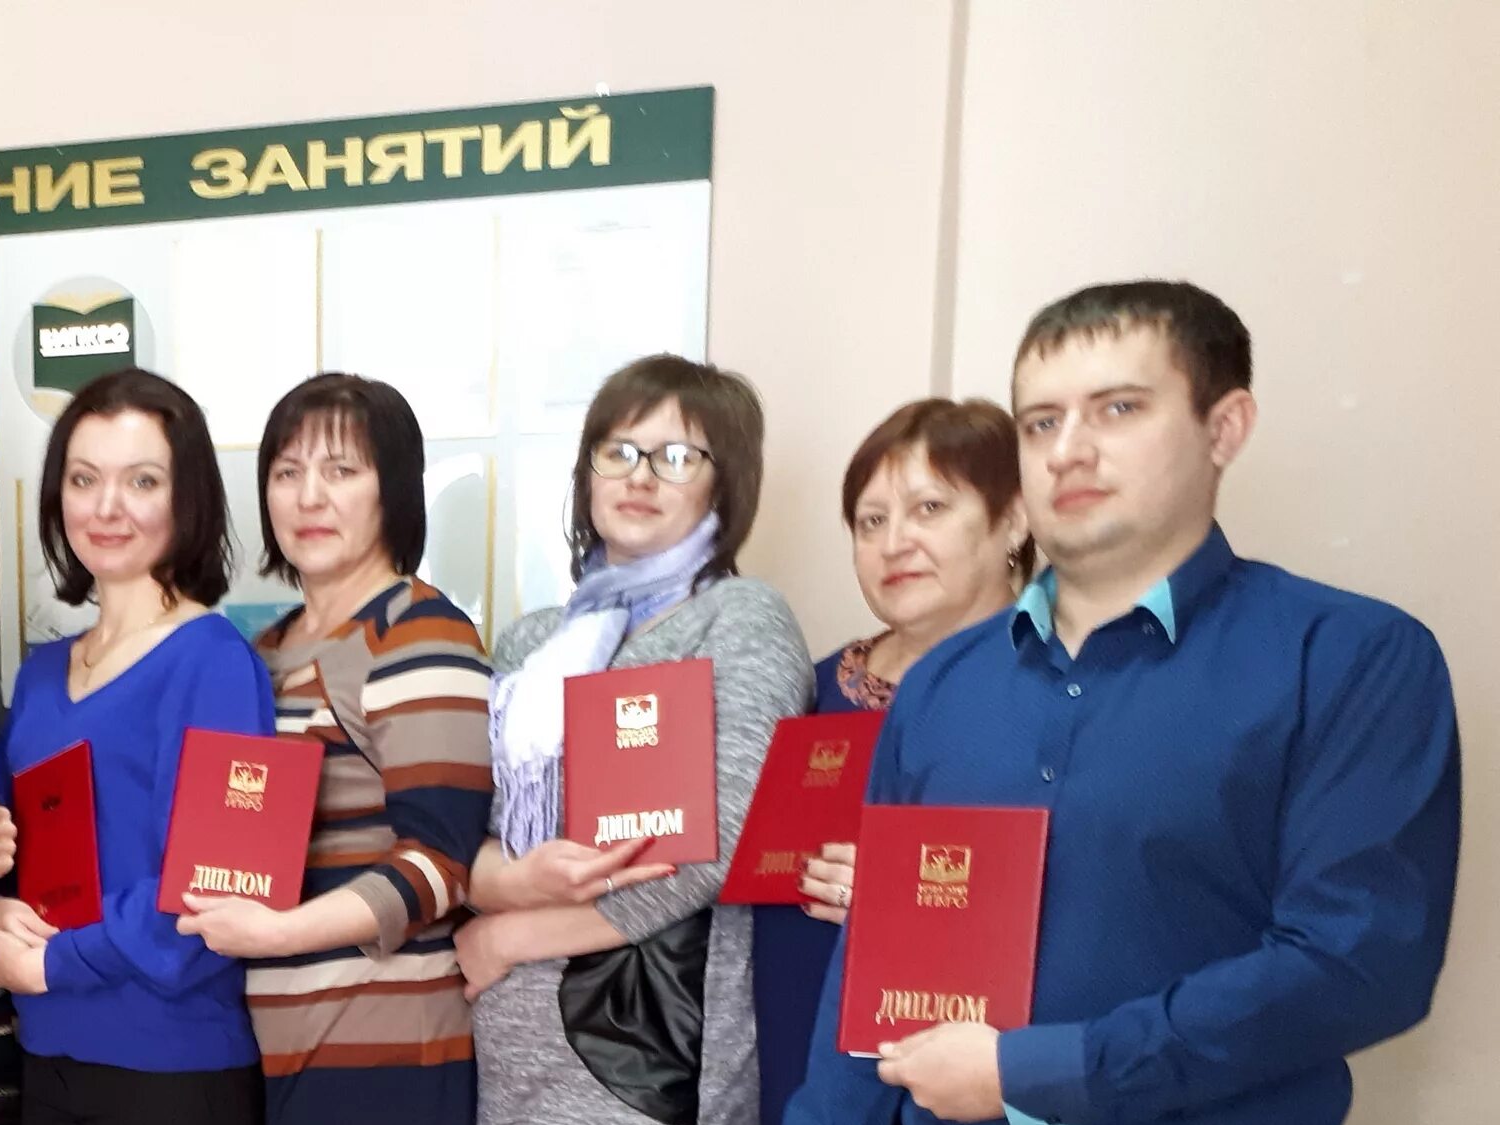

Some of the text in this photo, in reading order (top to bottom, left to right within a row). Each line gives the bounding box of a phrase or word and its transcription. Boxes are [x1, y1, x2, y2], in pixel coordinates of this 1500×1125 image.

[188, 103, 612, 200] ЗАНЯТИЙ
[594, 808, 685, 848] ДИПЛОМ
[188, 864, 273, 898] ДИПЛОМ
[875, 988, 989, 1026] ДИПЛОМ
